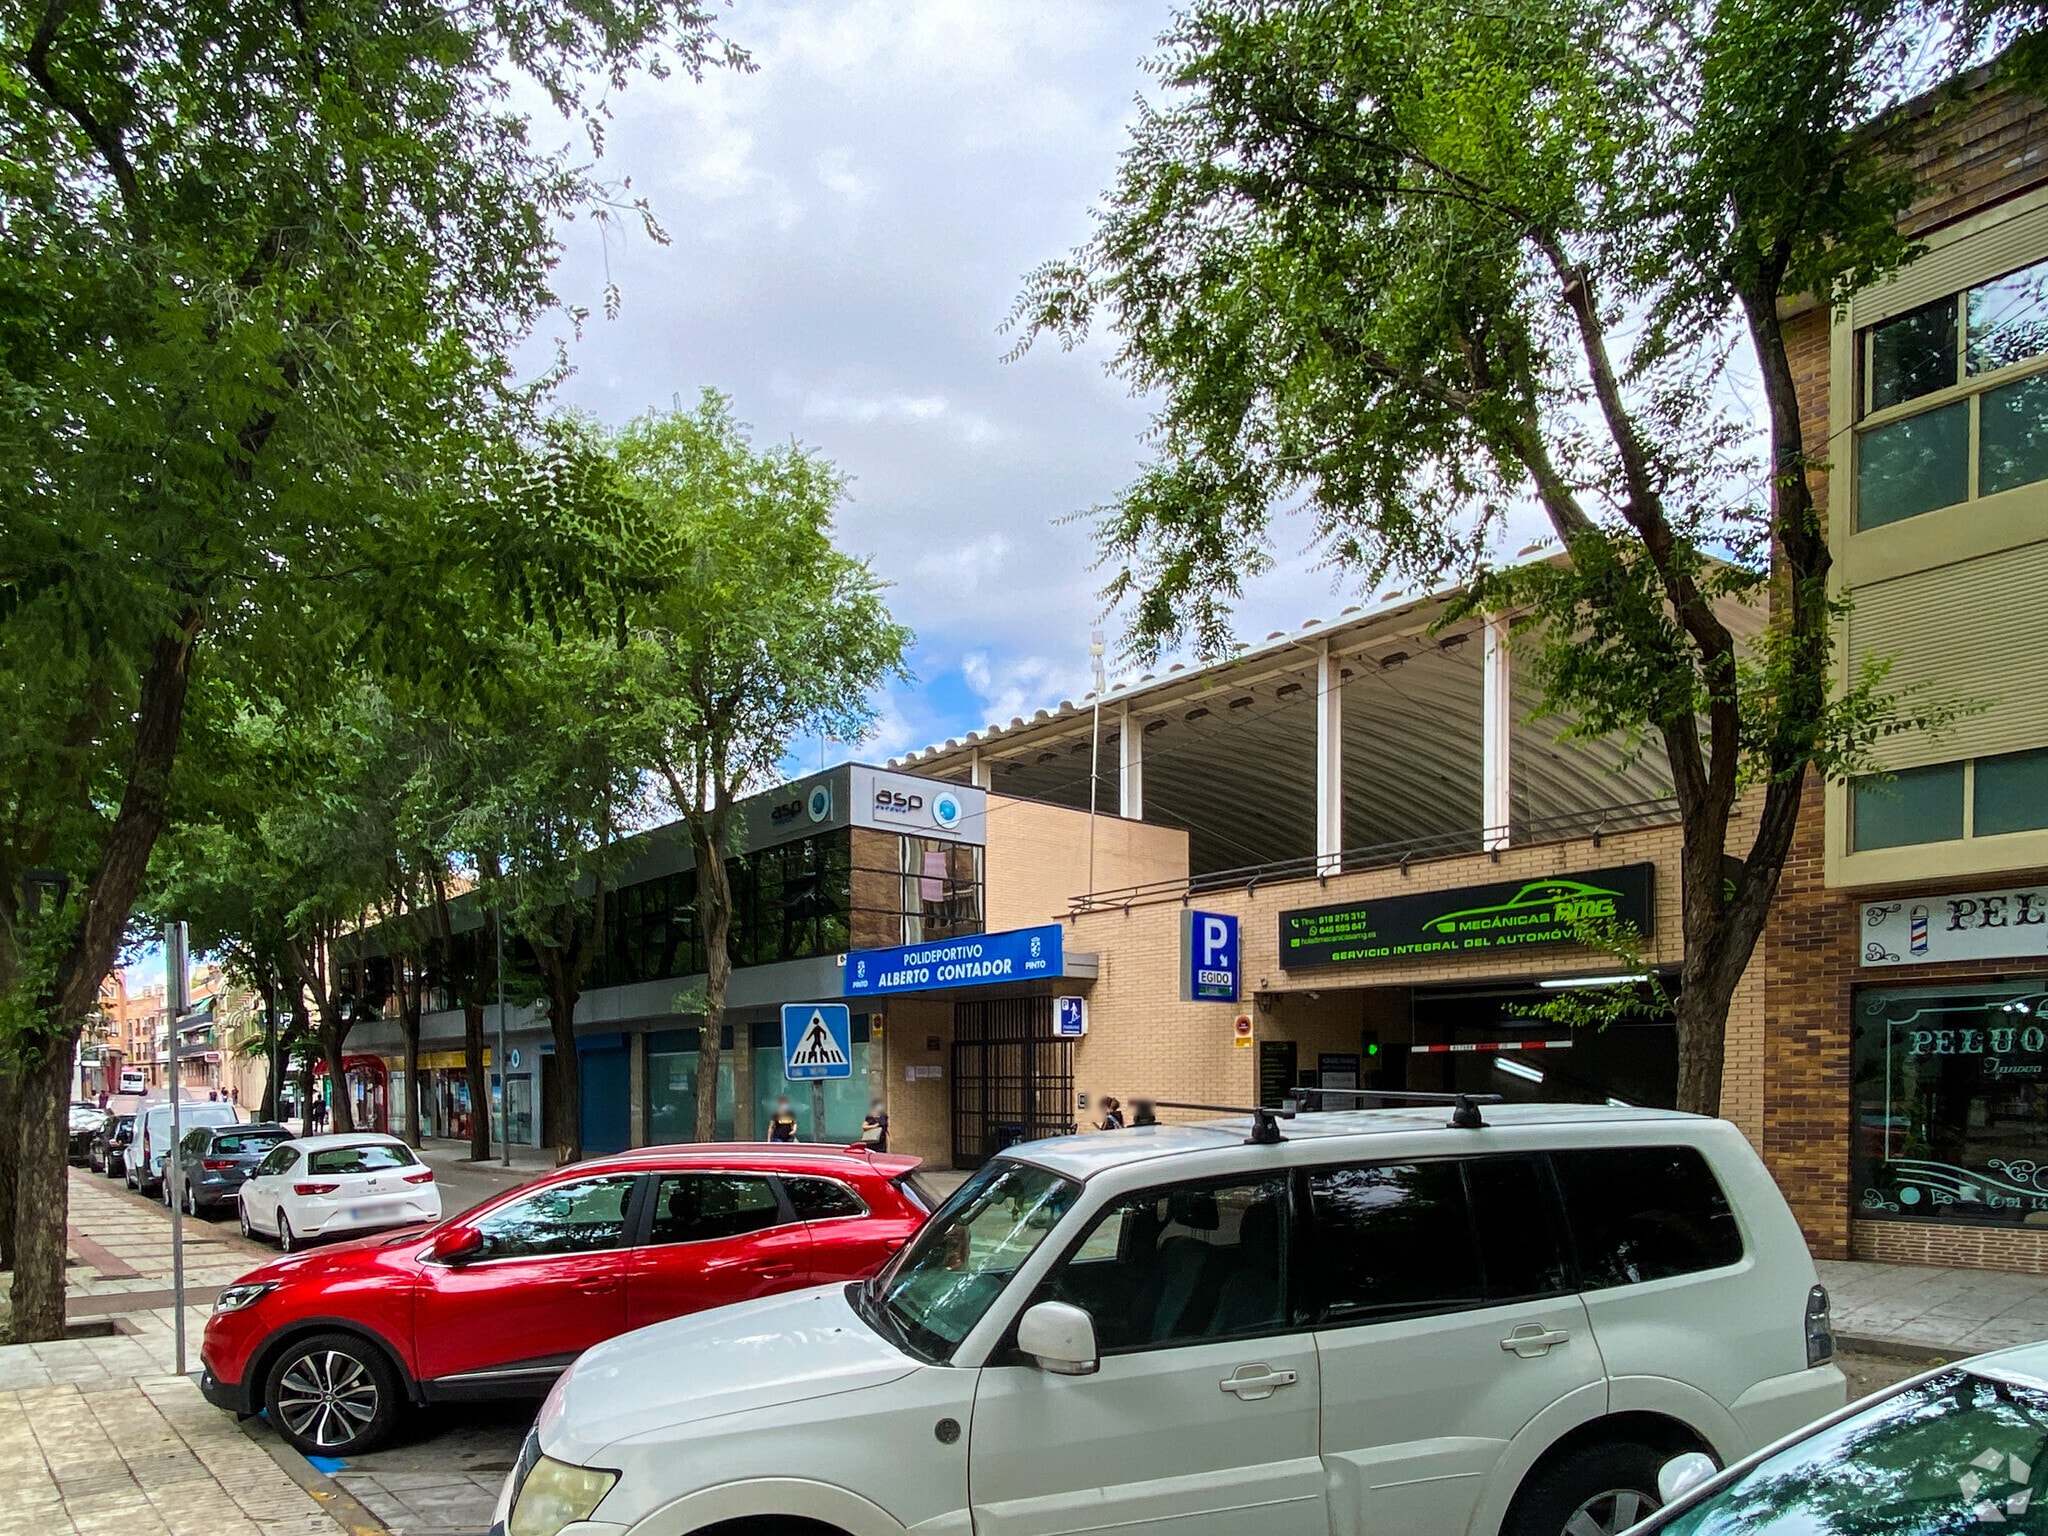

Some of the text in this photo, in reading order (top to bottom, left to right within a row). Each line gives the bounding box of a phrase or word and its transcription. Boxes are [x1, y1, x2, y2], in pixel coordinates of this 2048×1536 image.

[876, 789, 923, 811] asp
[1459, 913, 1550, 932] MECÁNICAS
[1946, 892, 2046, 931] PEL
[1204, 917, 1228, 966] P
[1332, 928, 1587, 961] SERVICIO INTEGRAL DEL AUTOMÓVI
[903, 944, 983, 966] POLIDEPORTIVO
[1025, 960, 1046, 970] PINTO
[878, 958, 1012, 987] ALBERTO CONTADOR
[1201, 971, 1229, 984] EGIDO
[852, 980, 868, 988] PINTO
